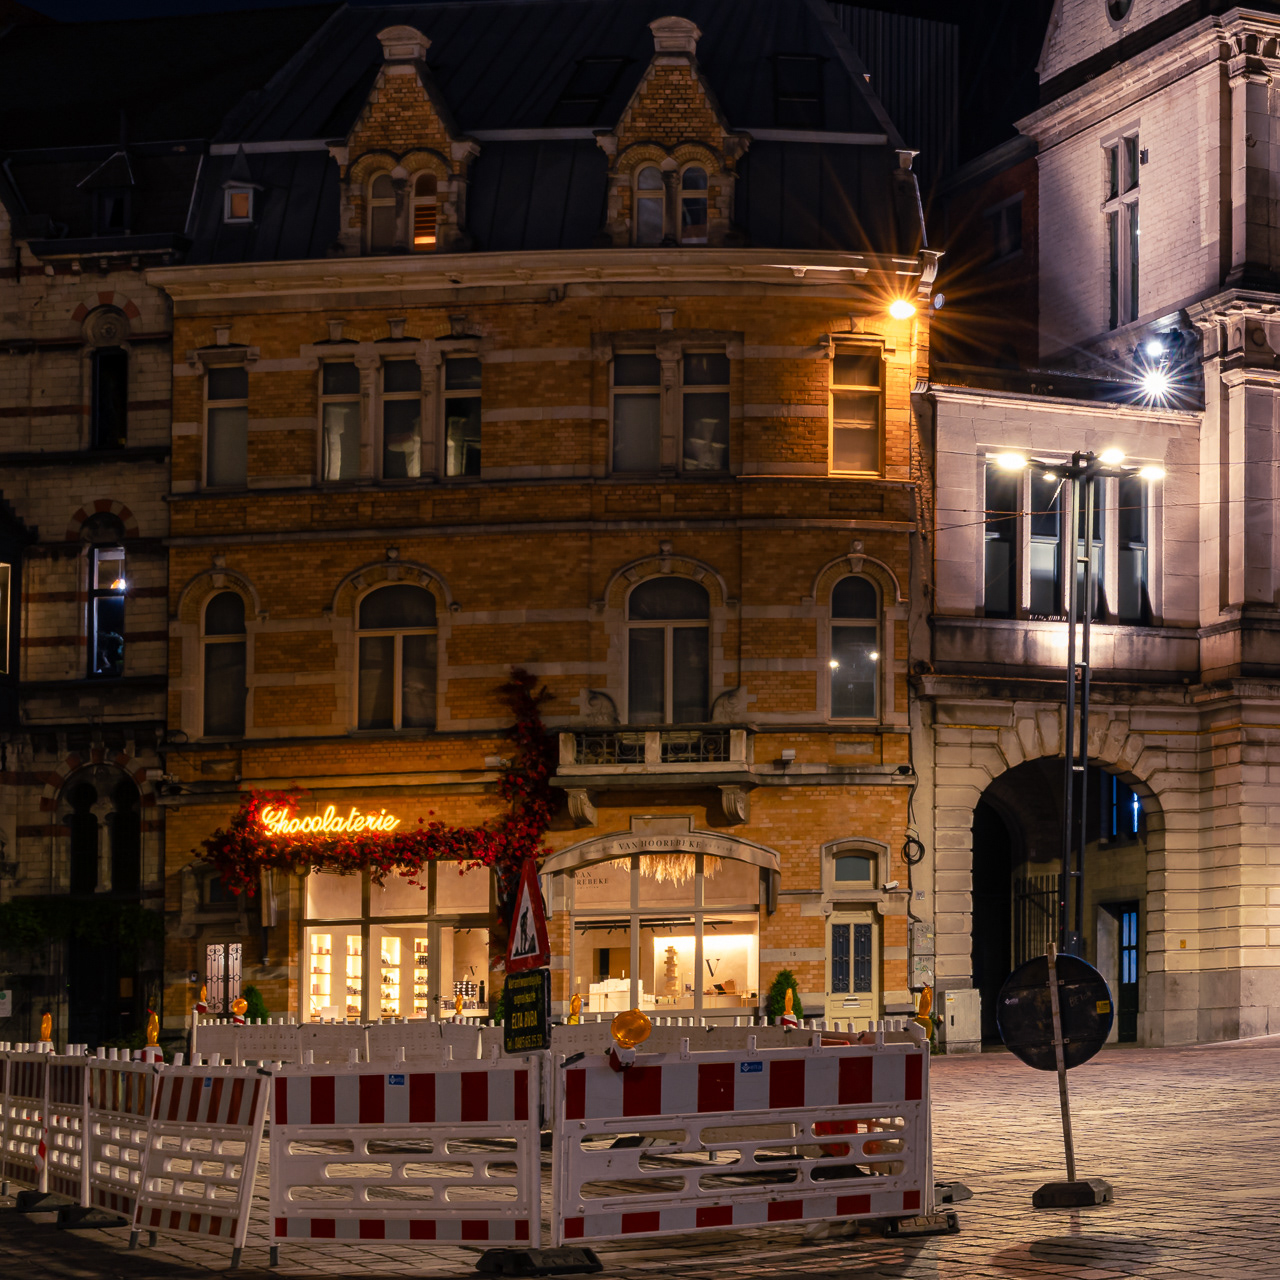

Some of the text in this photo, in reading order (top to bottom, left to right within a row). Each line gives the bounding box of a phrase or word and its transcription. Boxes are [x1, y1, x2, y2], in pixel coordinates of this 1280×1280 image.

[261, 805, 401, 836] Chocolaterie
[619, 841, 638, 850] VAN
[640, 839, 702, 849] HOOREBEKE
